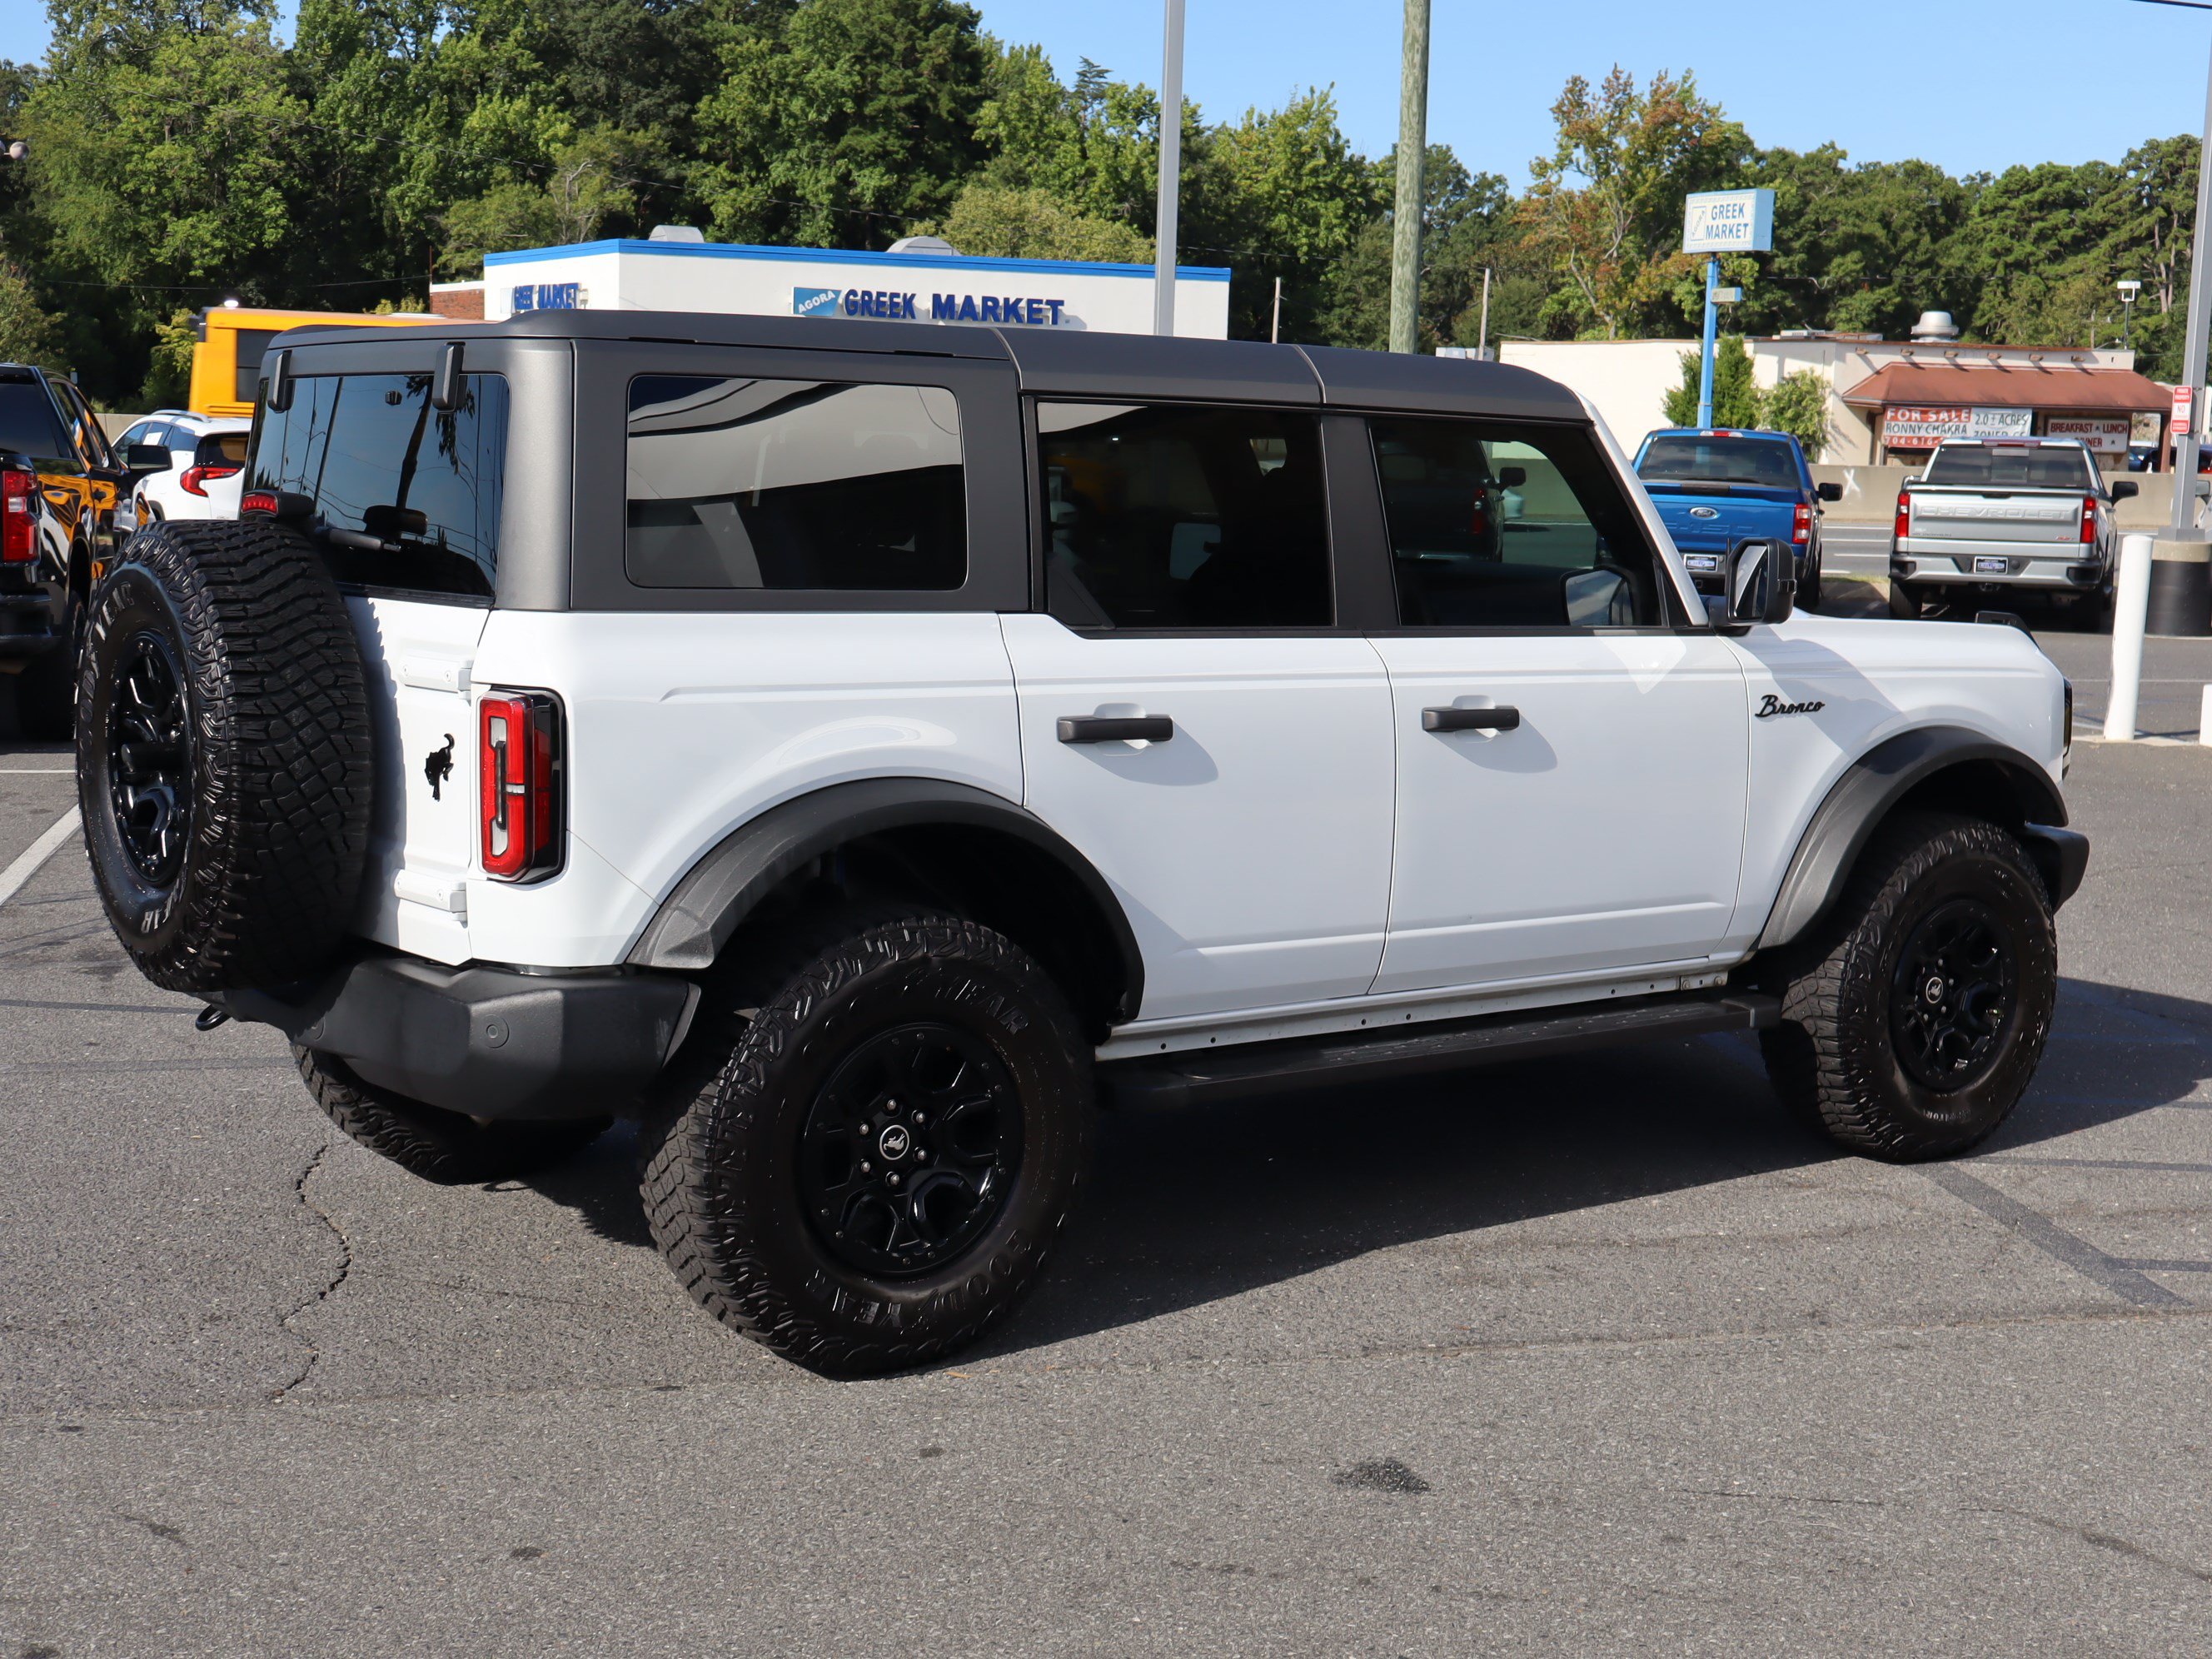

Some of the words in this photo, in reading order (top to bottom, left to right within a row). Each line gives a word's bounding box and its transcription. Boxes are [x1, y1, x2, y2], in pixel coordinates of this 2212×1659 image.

[1711, 203, 1746, 221] GREEK
[1706, 222, 1749, 240] MARKET
[515, 284, 535, 310] GREEK
[538, 282, 579, 309] MARKET
[798, 290, 835, 314] AGORA
[844, 288, 917, 320] GREEK
[932, 293, 1064, 326] MARKET
[1886, 409, 1921, 421] FOR
[1928, 409, 1970, 422] SALE
[2177, 404, 2186, 413] NO
[1975, 414, 1989, 426] 2.0
[1999, 413, 2028, 426] ACRES
[2050, 422, 2094, 432] BREAKFAST
[2103, 423, 2128, 433] LUNCH
[1886, 422, 1924, 435] RONNY
[1925, 424, 1967, 436] CHAKRA
[1920, 506, 2070, 520] CHEVROLET
[1755, 695, 1826, 717] Bronco
